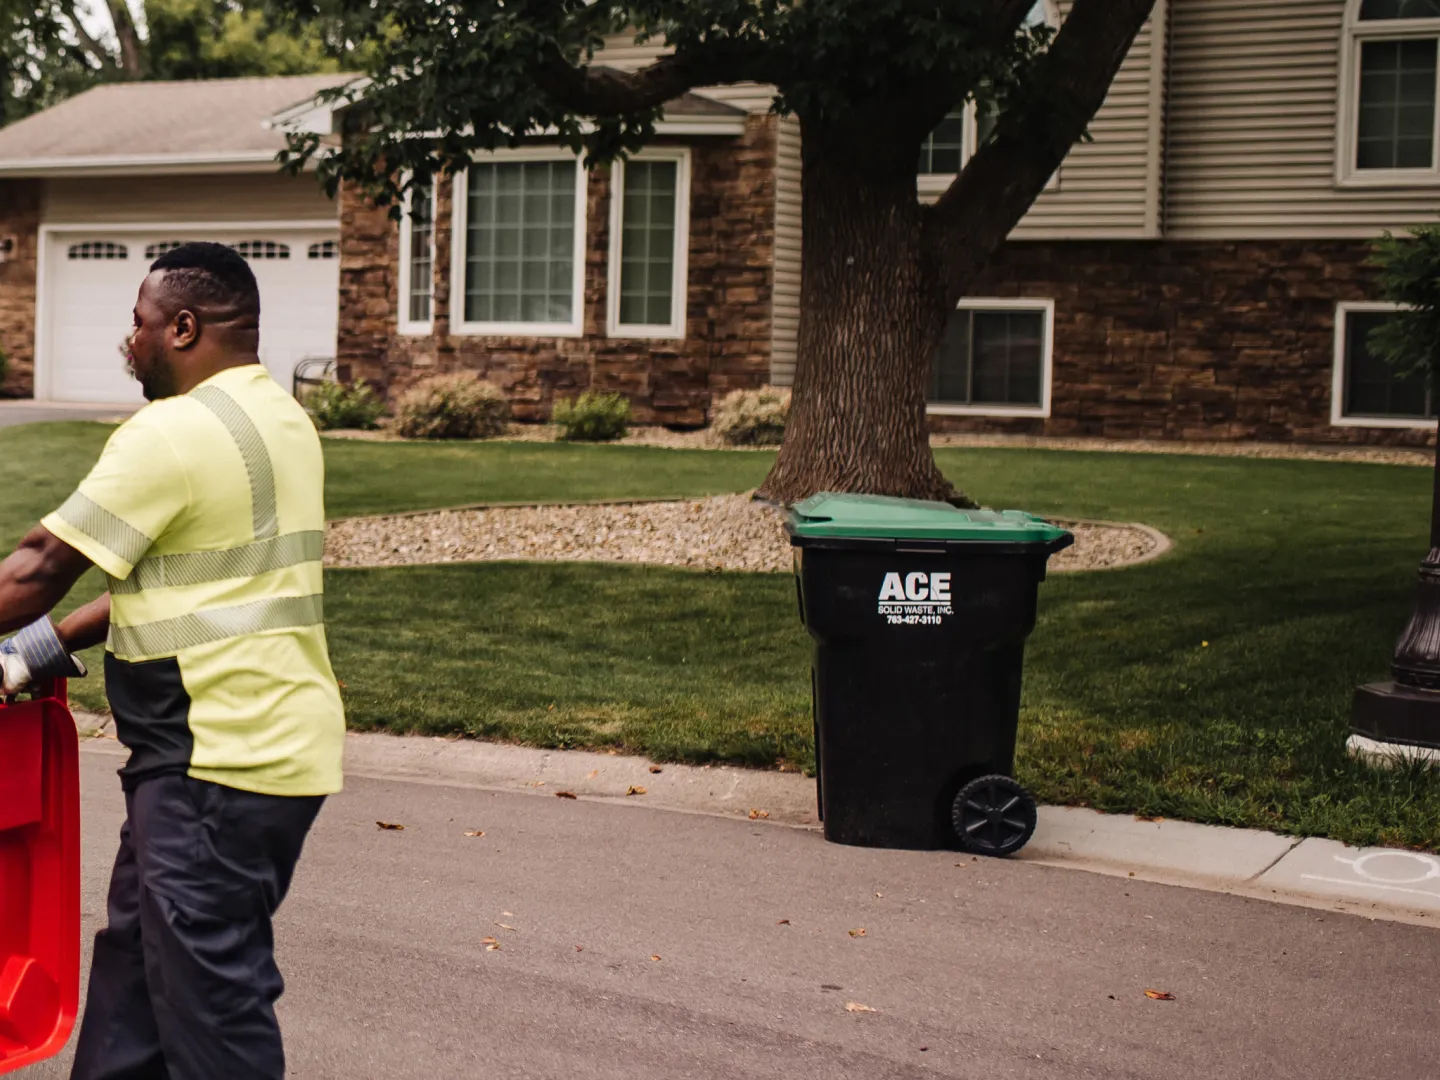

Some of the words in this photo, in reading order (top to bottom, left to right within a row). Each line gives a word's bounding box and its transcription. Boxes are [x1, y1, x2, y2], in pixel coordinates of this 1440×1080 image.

[878, 571, 951, 600] ACE
[878, 605, 903, 614] SOLID
[904, 605, 936, 615] WASTE,
[886, 615, 942, 625] 763-427-3110
